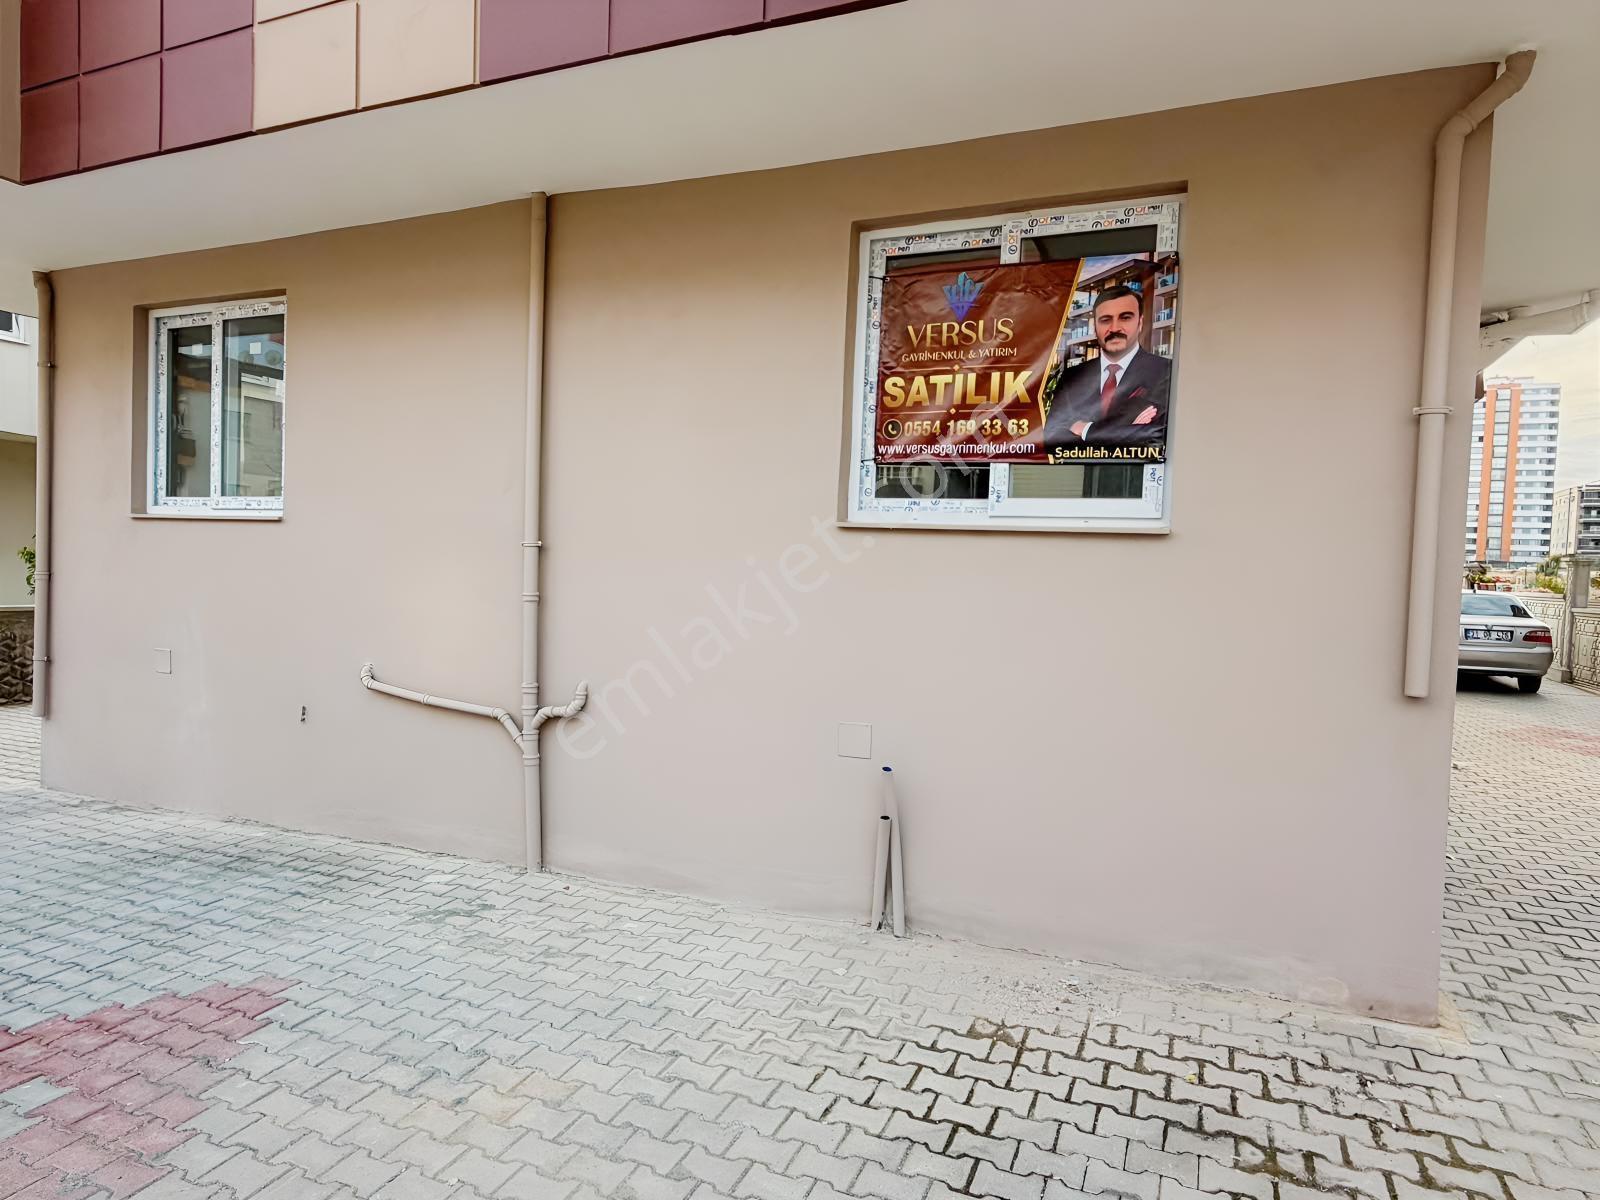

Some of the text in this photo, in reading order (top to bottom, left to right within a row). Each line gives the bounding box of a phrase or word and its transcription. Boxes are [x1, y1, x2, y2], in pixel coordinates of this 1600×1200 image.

[907, 317, 1014, 348] VERSUS
[902, 347, 1018, 362] GAYRİMENKUL & YATIRIM
[904, 418, 1029, 437] 0554 169 33 63
[878, 441, 1035, 458] www.versusgayrimenkul.com
[1055, 446, 1159, 459] Sadullah ALTUN
